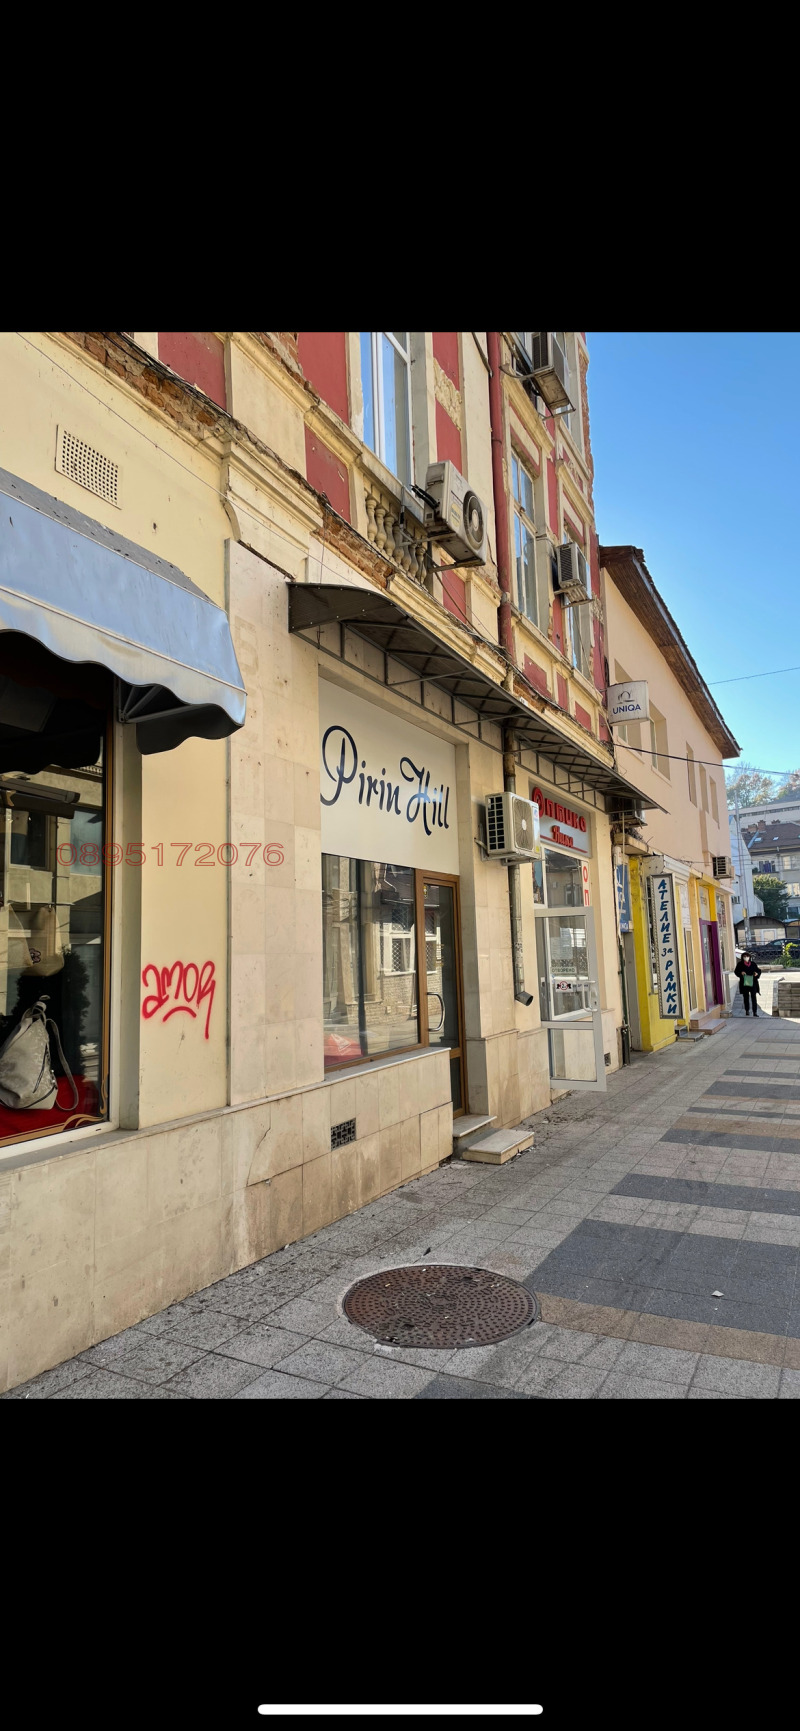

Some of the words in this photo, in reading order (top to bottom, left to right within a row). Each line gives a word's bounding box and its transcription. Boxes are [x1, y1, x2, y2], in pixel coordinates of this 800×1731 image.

[612, 704, 641, 714] UNIQA
[320, 725, 401, 815] Pirin
[400, 757, 449, 836] Hill
[658, 879, 672, 944] АТЕЛИЕ
[664, 960, 677, 1014] РАМКИ
